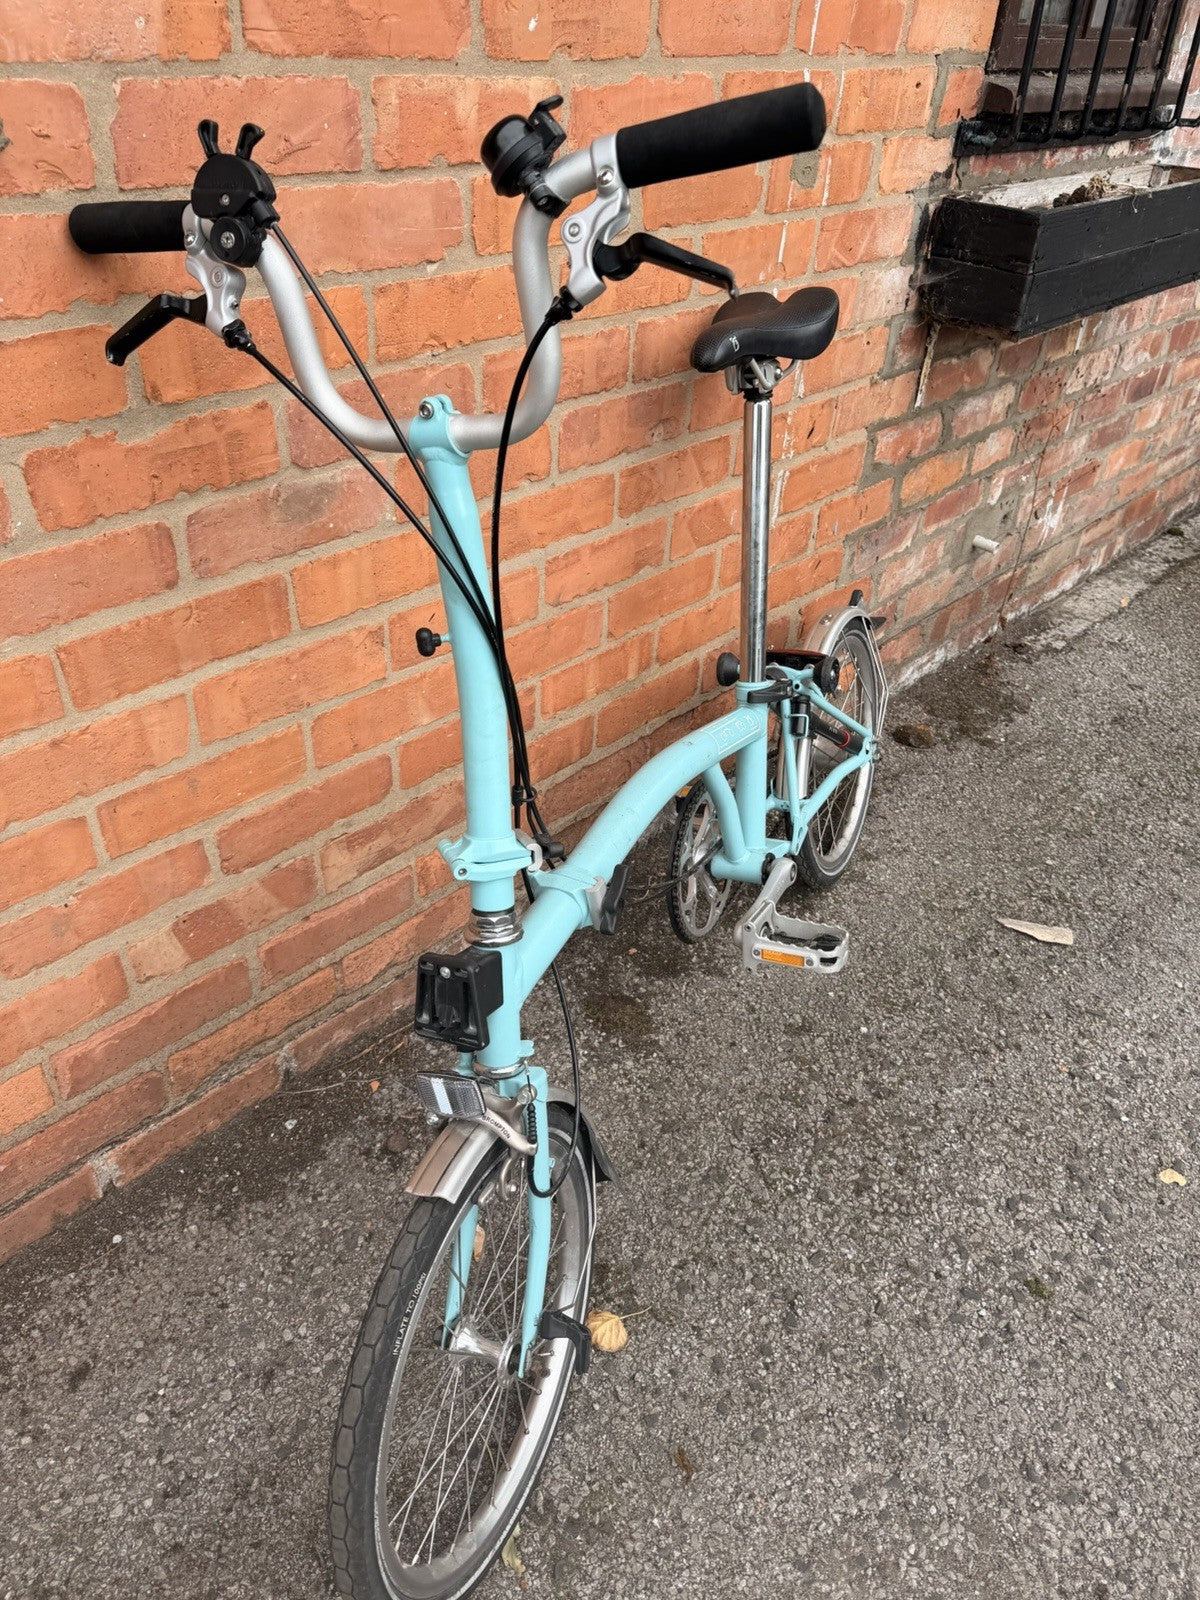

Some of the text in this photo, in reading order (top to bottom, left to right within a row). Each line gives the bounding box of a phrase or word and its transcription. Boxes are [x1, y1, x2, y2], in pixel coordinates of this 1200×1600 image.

[482, 1115, 511, 1139] BROMPTON
[392, 1316, 409, 1356] INFLATE
[405, 1299, 415, 1314] TO
